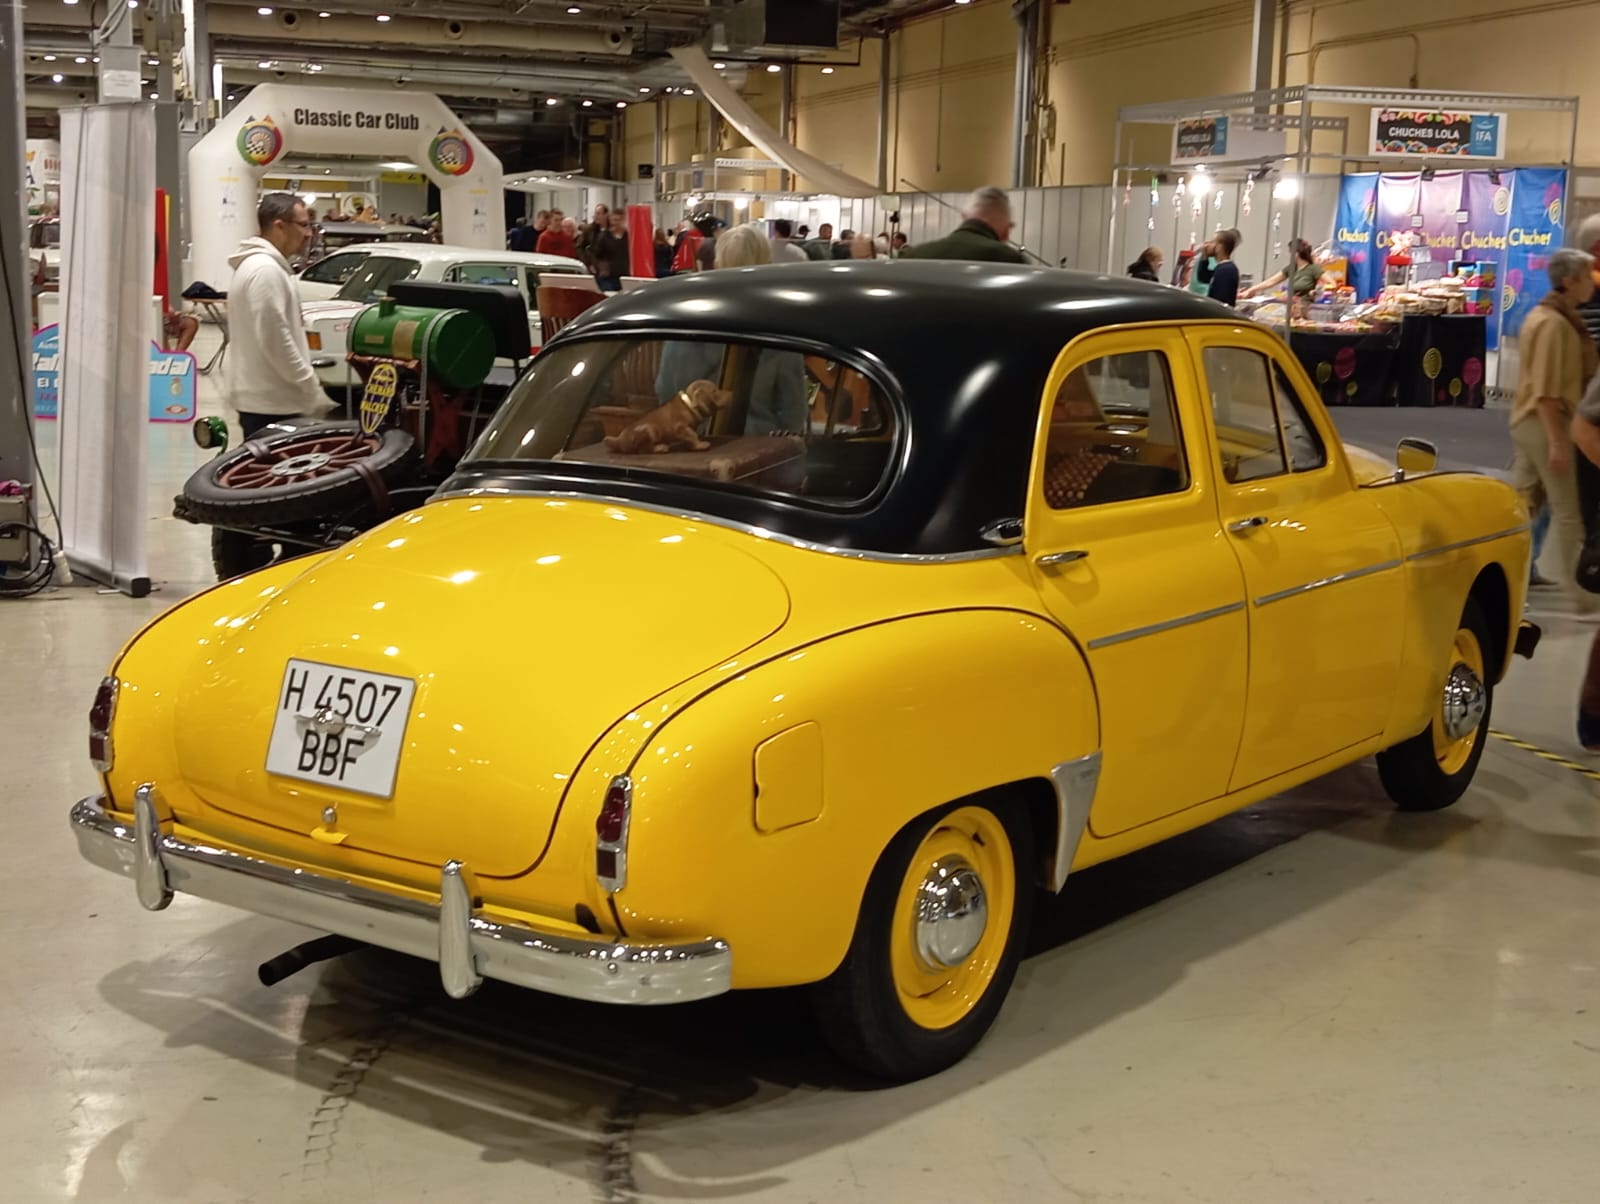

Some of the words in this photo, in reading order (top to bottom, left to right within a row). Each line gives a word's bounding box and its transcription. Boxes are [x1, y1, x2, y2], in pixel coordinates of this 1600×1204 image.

[294, 108, 352, 127] Classic
[355, 111, 382, 128] Car
[385, 113, 419, 130] Club
[1388, 127, 1433, 138] CHUCHES
[1435, 129, 1460, 139] LOLA
[1475, 131, 1492, 141] IFA
[1461, 230, 1507, 250] Chuches
[284, 668, 309, 712] H
[314, 675, 402, 727] 4507
[298, 729, 366, 781] BBF
